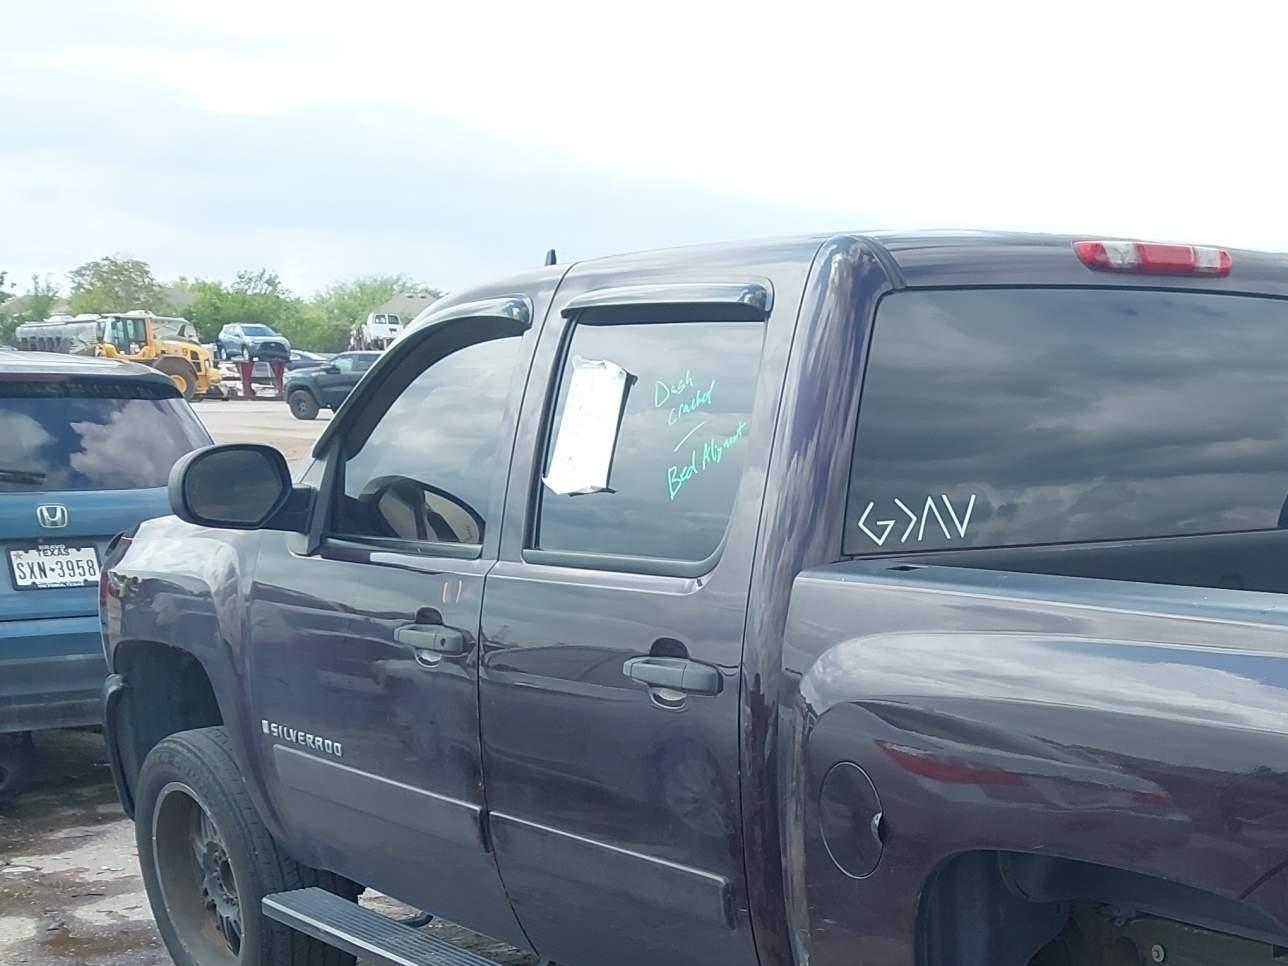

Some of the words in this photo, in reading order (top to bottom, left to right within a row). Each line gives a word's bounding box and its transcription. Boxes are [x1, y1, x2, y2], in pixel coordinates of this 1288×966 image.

[668, 450, 698, 500] Bed
[38, 548, 70, 557] TEXAS
[270, 723, 342, 757] SILVERADO
